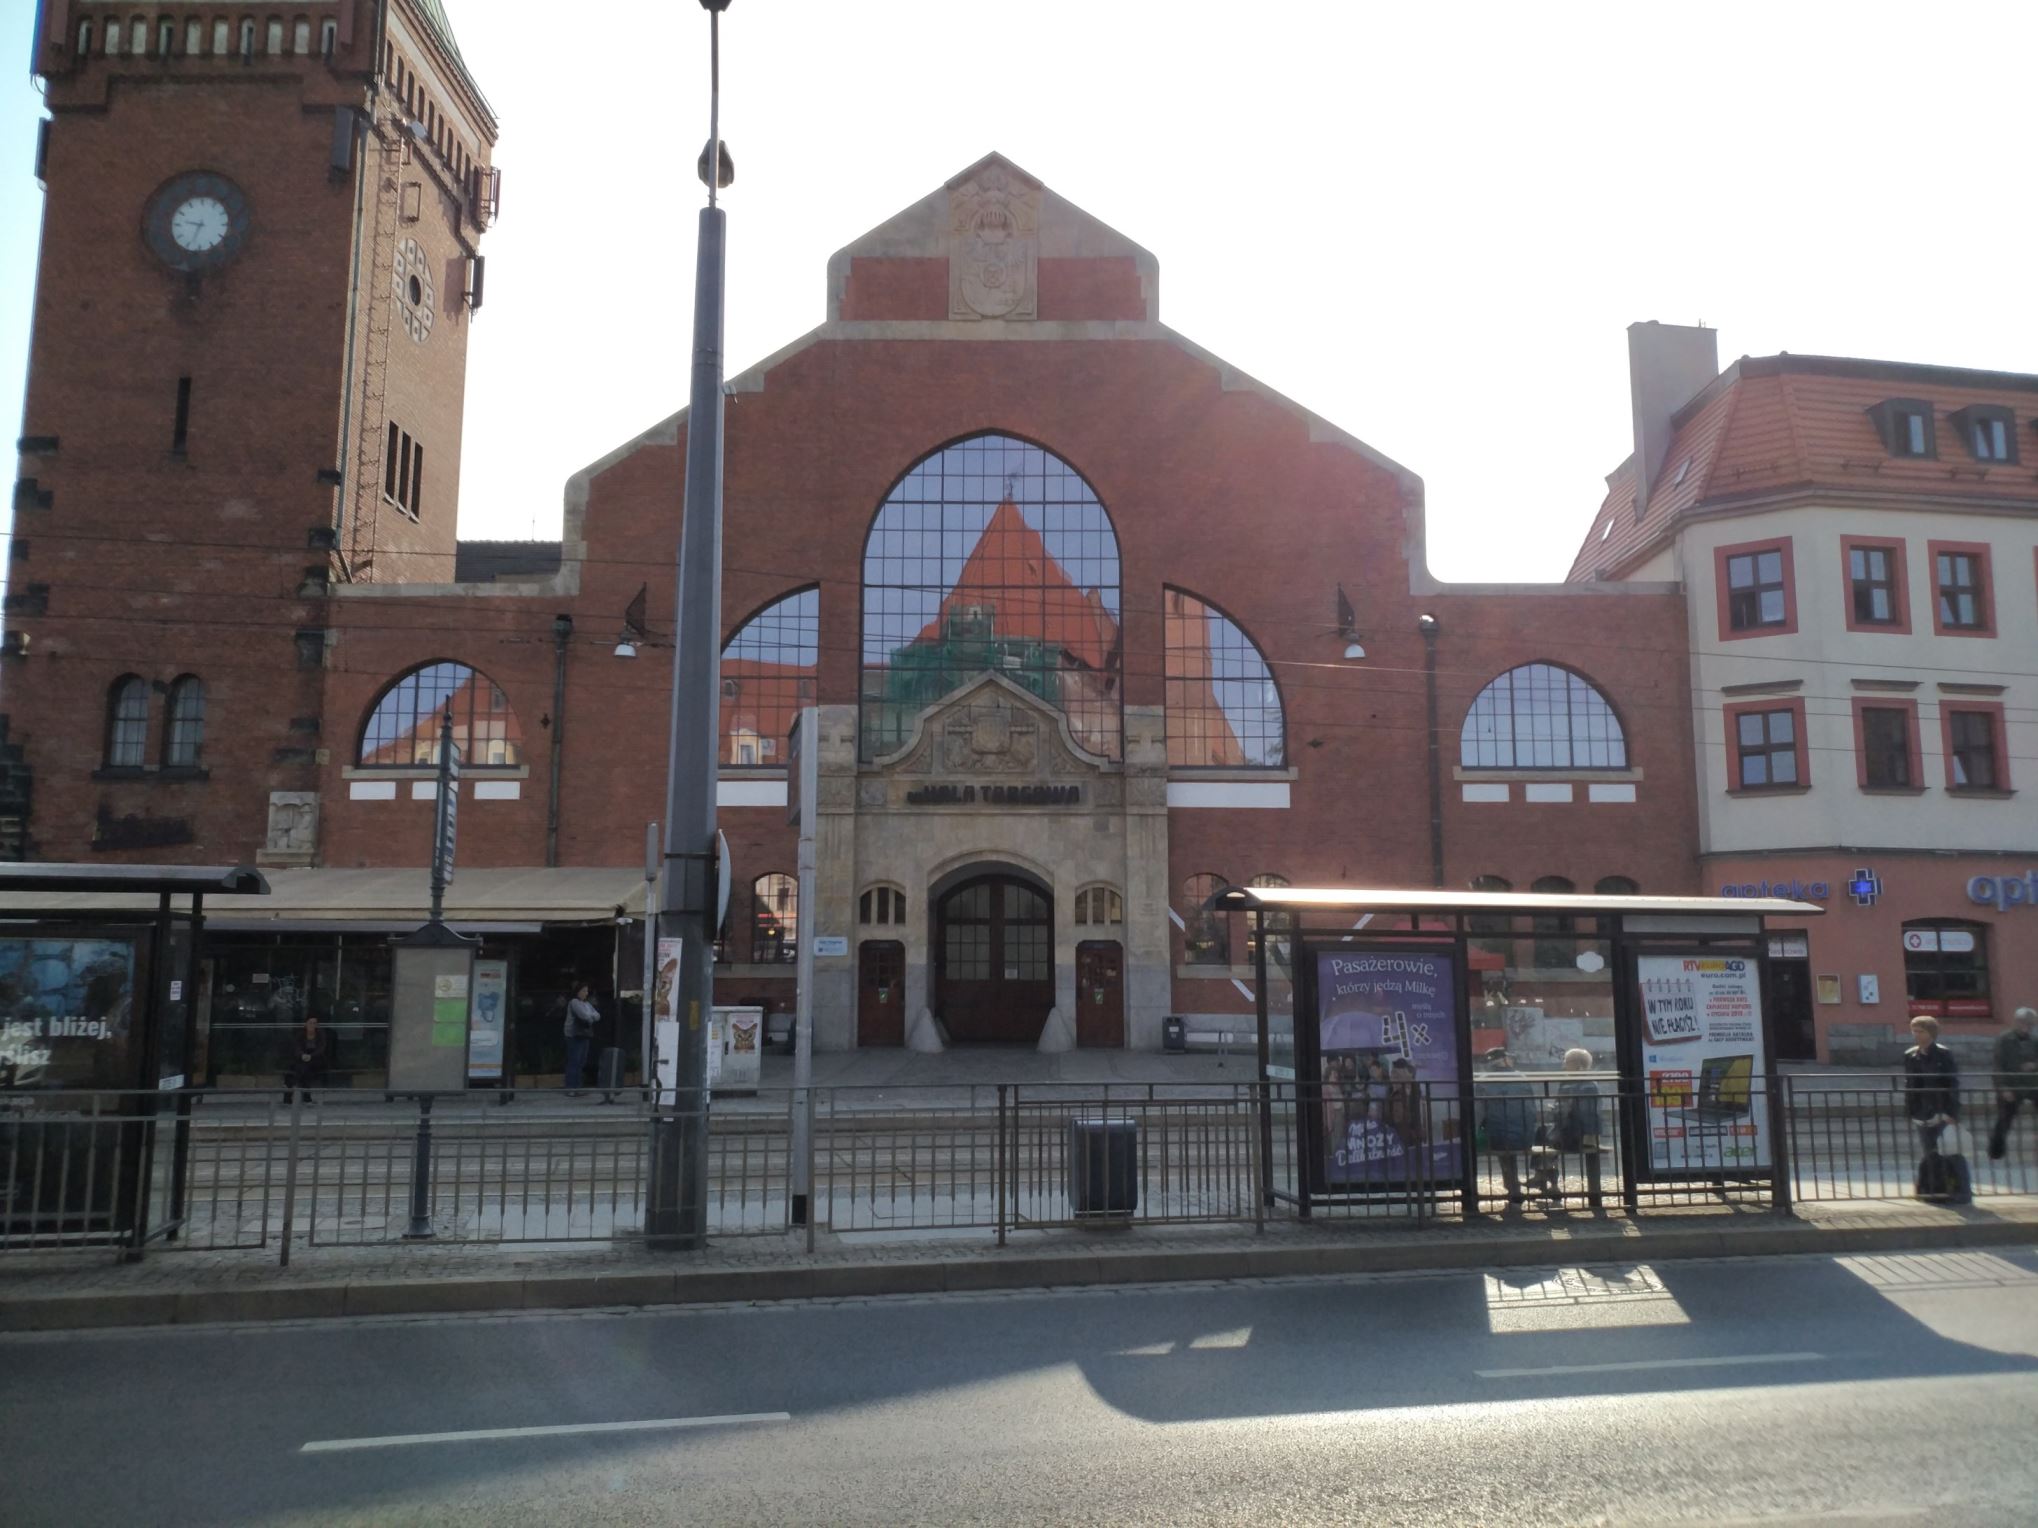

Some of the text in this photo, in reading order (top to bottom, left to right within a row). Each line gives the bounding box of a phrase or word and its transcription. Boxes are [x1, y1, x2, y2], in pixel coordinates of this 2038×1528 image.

[923, 785, 975, 803] HALA
[980, 785, 1080, 804] TARGOWA
[1722, 880, 1829, 899] apteka
[1332, 956, 1438, 978] Pasażerowie,
[1336, 979, 1436, 998] którzy jedzą Milkę
[1648, 997, 1694, 1014] W TYM ROKU
[1, 1016, 112, 1040] jest bliżej,
[1652, 1017, 1668, 1035] NIE
